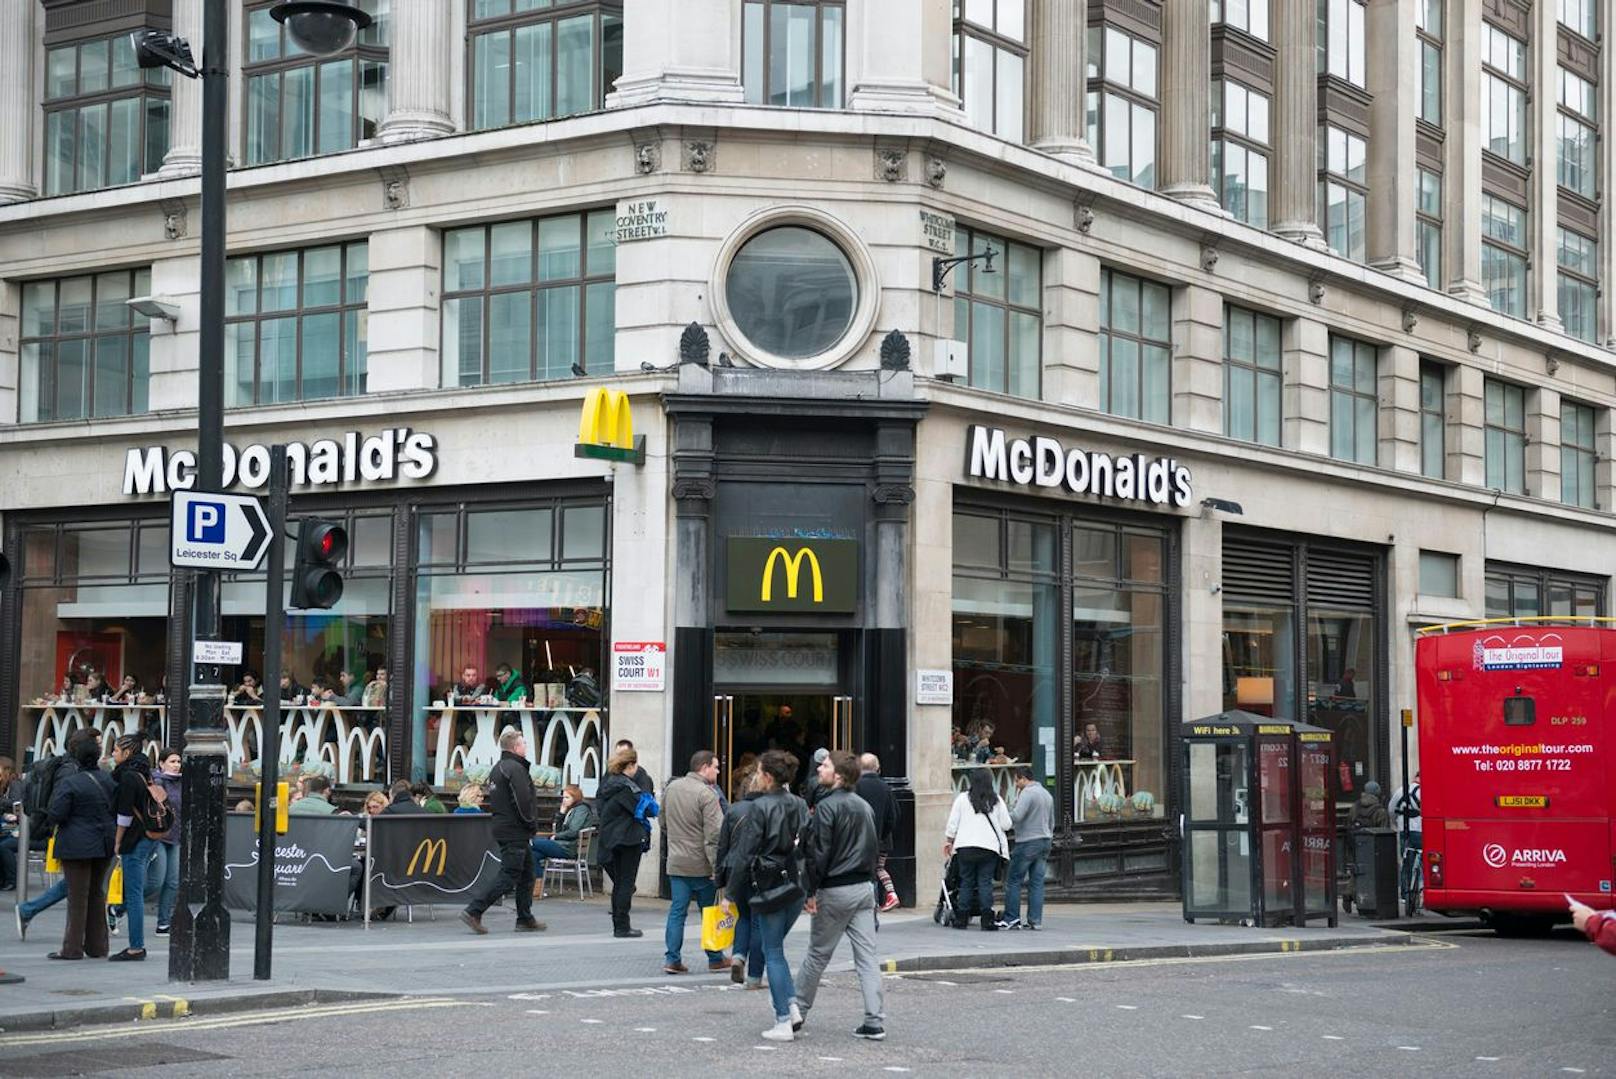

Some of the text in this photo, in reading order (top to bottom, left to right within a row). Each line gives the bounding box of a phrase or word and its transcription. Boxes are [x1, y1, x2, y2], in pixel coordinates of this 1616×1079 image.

[629, 201, 656, 214] NEW
[616, 211, 668, 227] COVENTRY
[617, 225, 652, 240] STREET
[923, 224, 951, 240] STREET
[968, 424, 1193, 508] McDonald's
[194, 504, 219, 540] P
[177, 549, 237, 562] Leicester Sq
[619, 655, 645, 666] SWISS
[1489, 647, 1560, 662] The Original Tour
[618, 667, 660, 678] COURT W1
[1551, 717, 1568, 725] DLP
[1193, 726, 1230, 735] WiFi here
[1451, 743, 1594, 756] www.theoriginaltour.com
[1474, 759, 1572, 771] Tel: 020 8877 1722
[1512, 849, 1567, 863] ARRIVA
